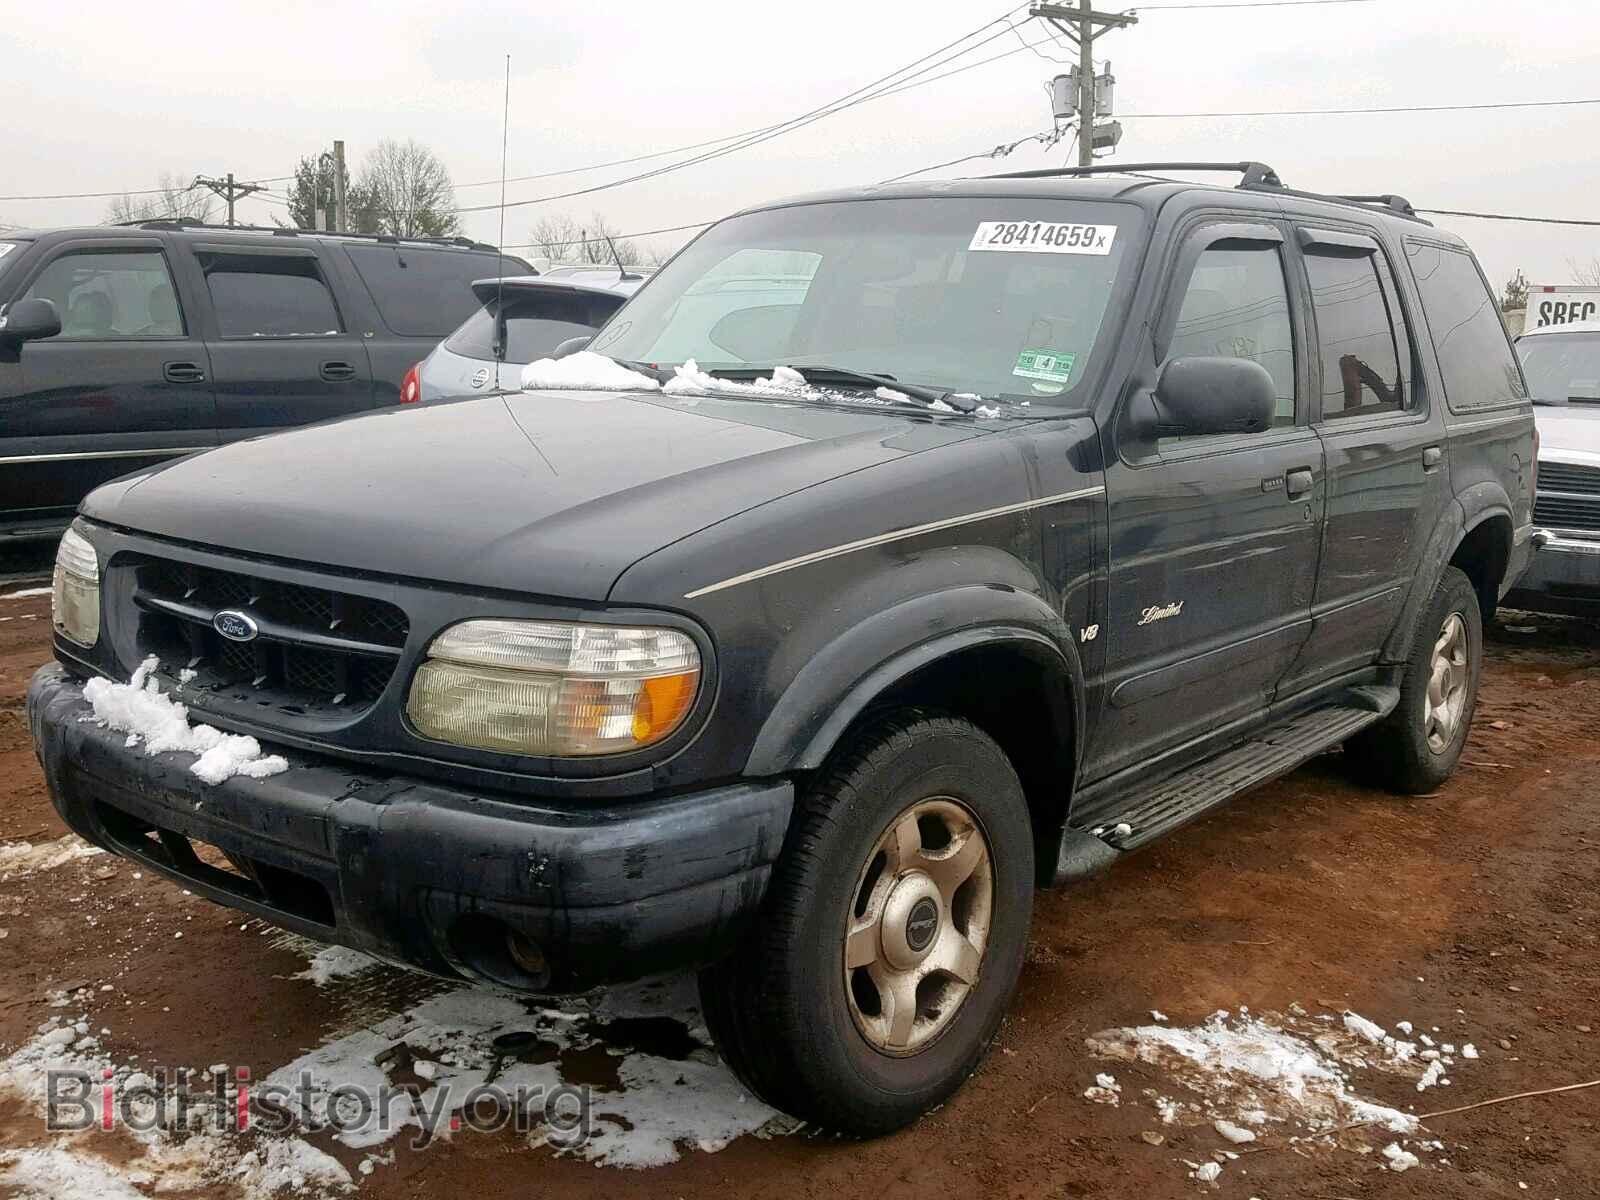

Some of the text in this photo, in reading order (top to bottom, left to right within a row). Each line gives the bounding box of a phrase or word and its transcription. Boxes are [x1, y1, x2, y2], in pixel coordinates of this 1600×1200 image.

[988, 223, 1096, 248] 28414659
[1137, 600, 1185, 626] Limited
[1080, 624, 1099, 643] V8
